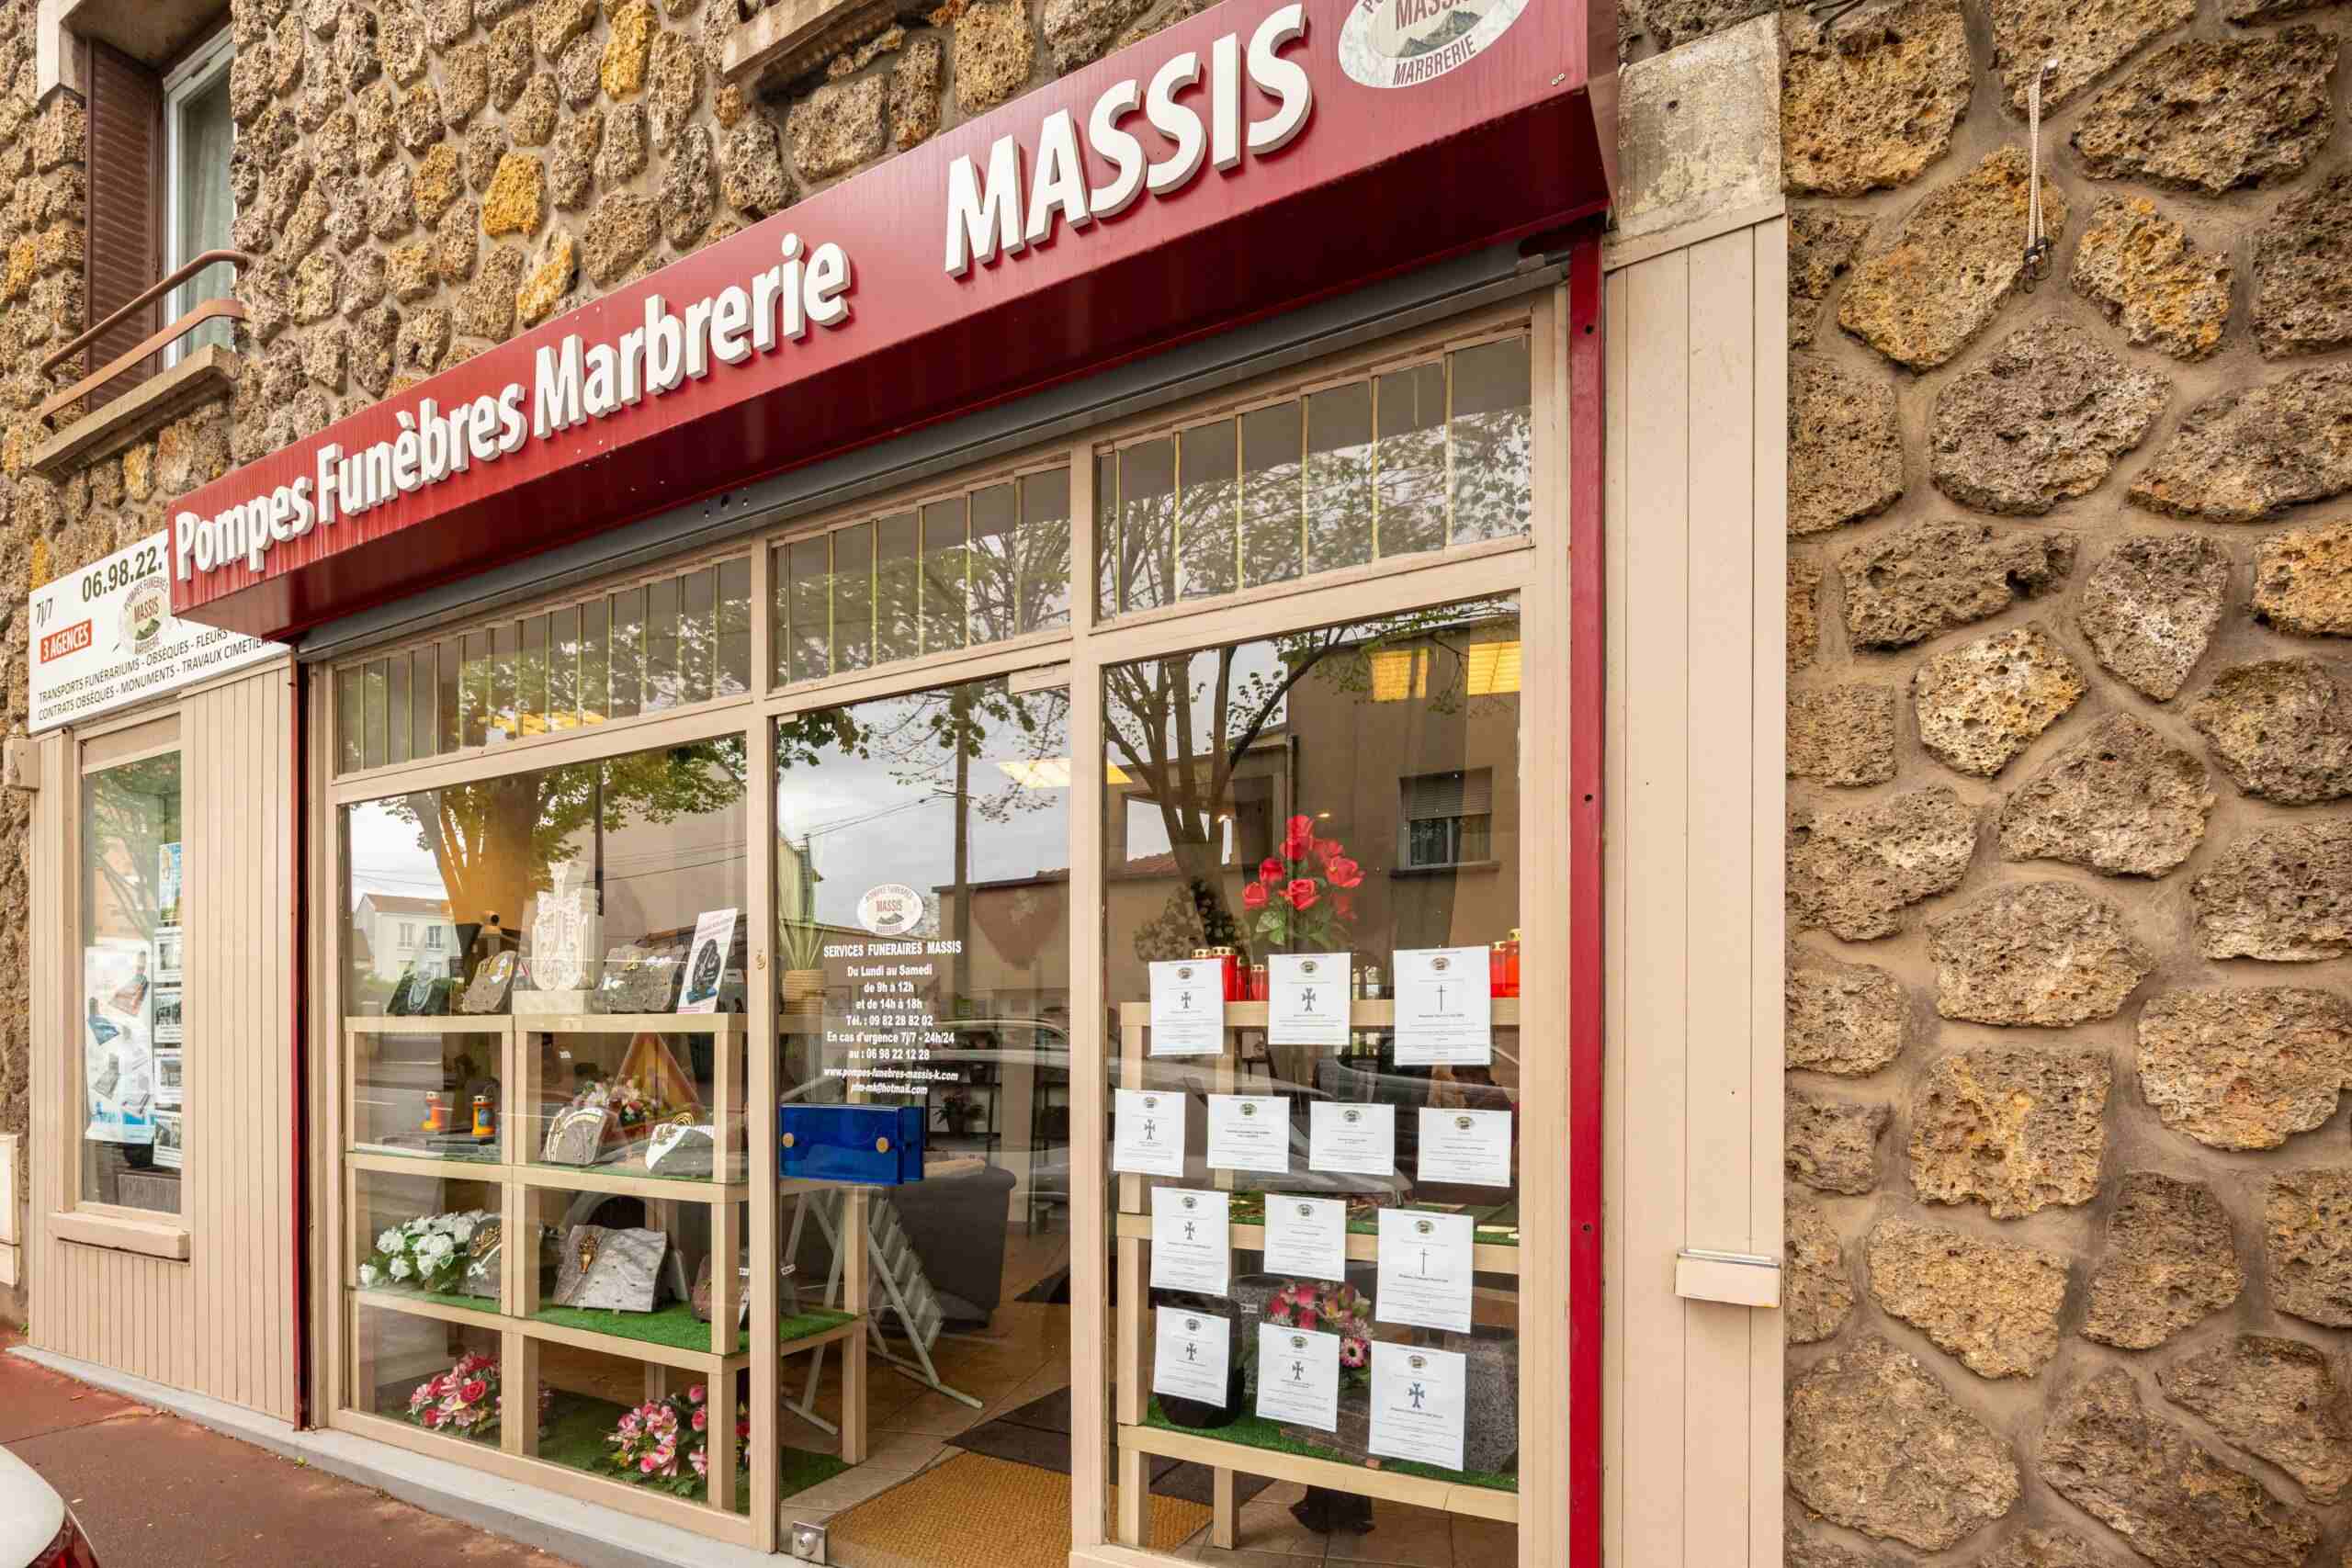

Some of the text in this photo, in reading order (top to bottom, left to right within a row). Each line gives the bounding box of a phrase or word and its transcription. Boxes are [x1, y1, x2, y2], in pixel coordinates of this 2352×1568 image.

[1393, 35, 1476, 85] MARBRERIE
[175, 3, 1314, 581] Pompes Funèbres Marbrerie MASSIS
[82, 544, 168, 604] 06.98.22.
[42, 624, 89, 660] 3 AGENCES
[39, 698, 74, 721] CONTRATS
[120, 663, 175, 694] MONUMENTS
[182, 648, 222, 673] TRAVAUX
[39, 678, 84, 705] TRANSPORTS
[823, 941, 962, 957] SERVICES FUNERAIRES MASSIS
[847, 963, 933, 976] Du Lundi au Samedi
[864, 983, 876, 993] de
[876, 982, 888, 993] 9h
[898, 981, 914, 993] 12h
[855, 998, 865, 1010] et
[866, 998, 878, 1010] de
[880, 998, 896, 1010] 14h
[906, 998, 922, 1009] 18h
[868, 1015, 880, 1026] 09
[882, 1015, 894, 1026] 82
[895, 1015, 906, 1026] 28
[922, 1014, 933, 1026] 02
[827, 1032, 837, 1043] En
[839, 1034, 854, 1043] cas
[856, 1032, 898, 1045] d'urgence
[866, 1048, 876, 1059] 06
[878, 1049, 890, 1059] 98
[892, 1049, 903, 1059] 22
[906, 1049, 916, 1059] 12
[919, 1049, 930, 1060] 28
